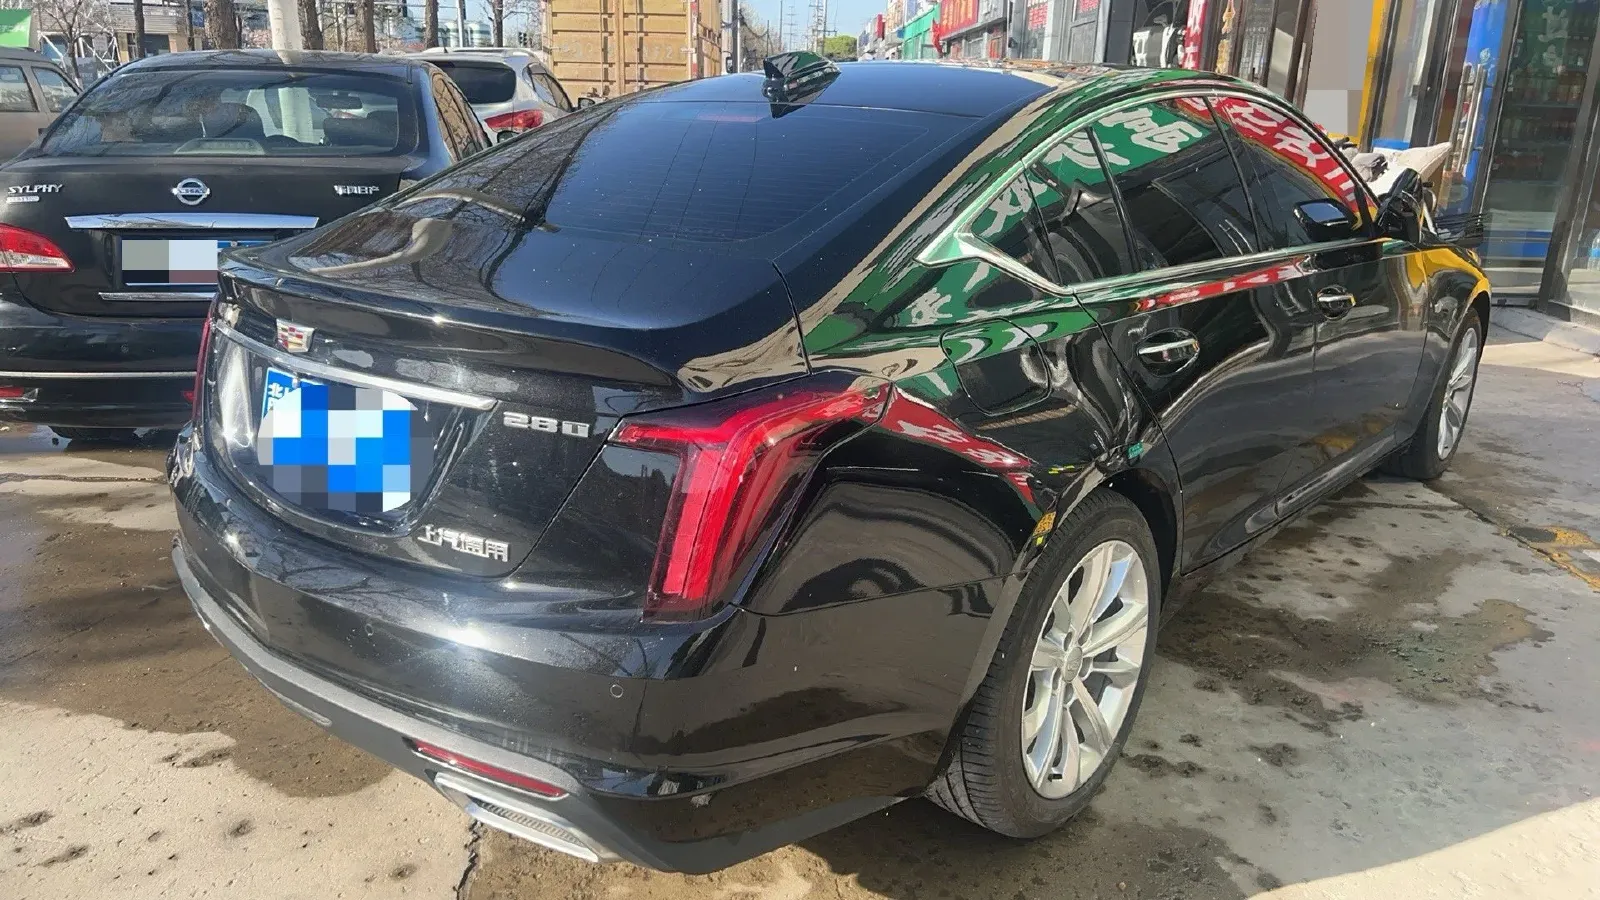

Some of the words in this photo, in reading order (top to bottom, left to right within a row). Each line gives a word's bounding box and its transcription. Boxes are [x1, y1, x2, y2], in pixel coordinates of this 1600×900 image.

[7, 184, 63, 194] SYLPHY
[503, 411, 590, 438] 28T
[417, 523, 511, 562] 上汽通用
